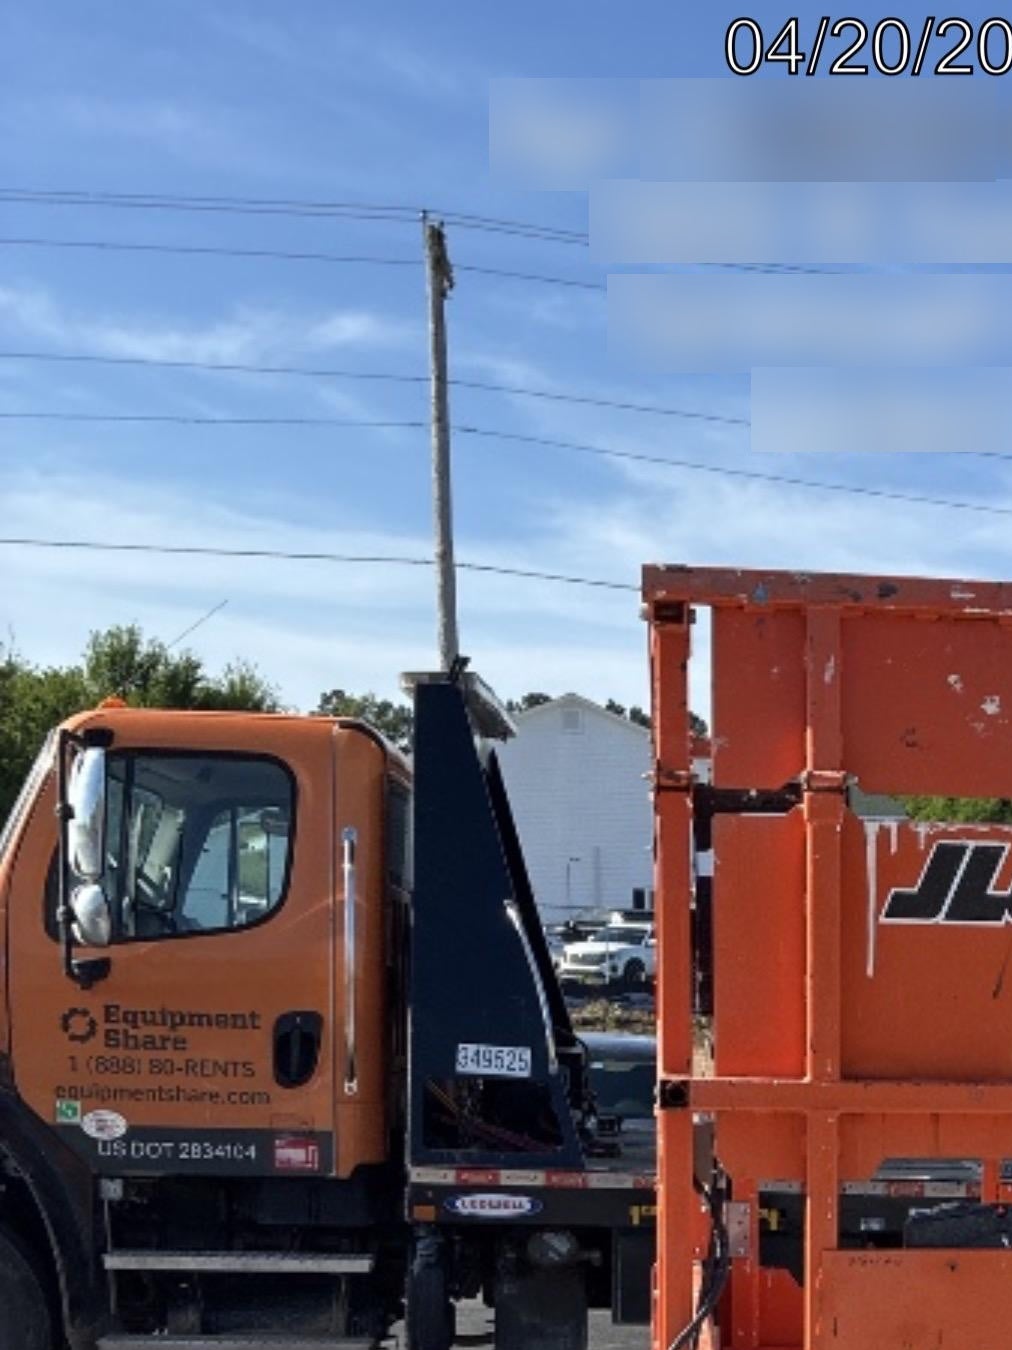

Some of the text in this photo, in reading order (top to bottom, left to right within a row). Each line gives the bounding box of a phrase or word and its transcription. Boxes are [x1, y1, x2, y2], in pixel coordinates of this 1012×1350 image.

[104, 1005, 261, 1031] Equipment
[104, 1029, 187, 1051] Share
[69, 1056, 78, 1072] 1
[149, 1058, 256, 1077] 80-RENTS
[55, 1084, 271, 1105] equipmentshare.com
[98, 1140, 126, 1158] US
[131, 1140, 174, 1159] DOT
